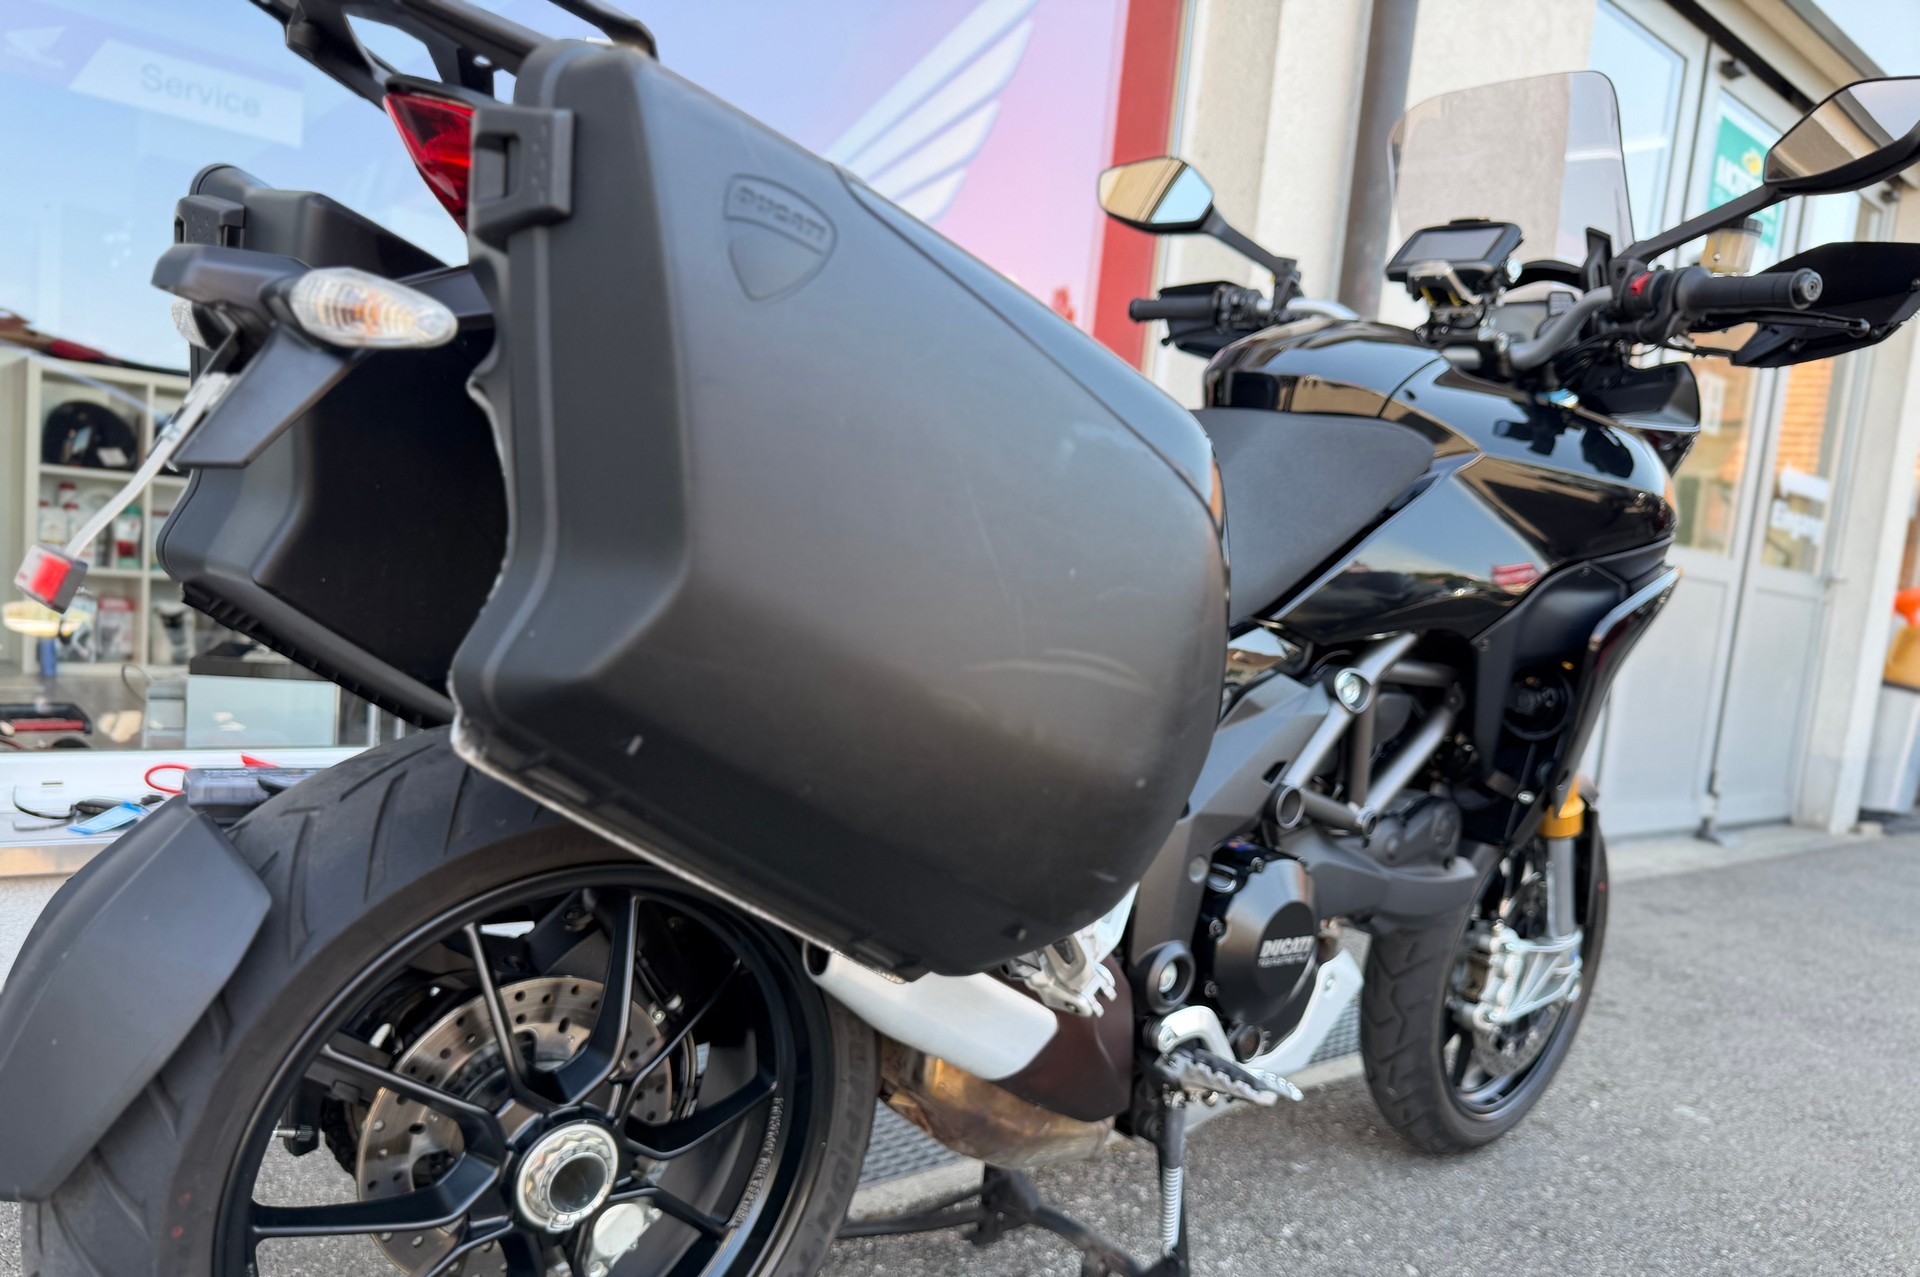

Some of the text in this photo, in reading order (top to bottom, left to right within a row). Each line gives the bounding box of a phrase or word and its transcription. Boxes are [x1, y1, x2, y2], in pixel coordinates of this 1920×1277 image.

[140, 62, 262, 118] Service
[734, 185, 828, 242] DUCATI
[1258, 935, 1316, 958] DUCATI
